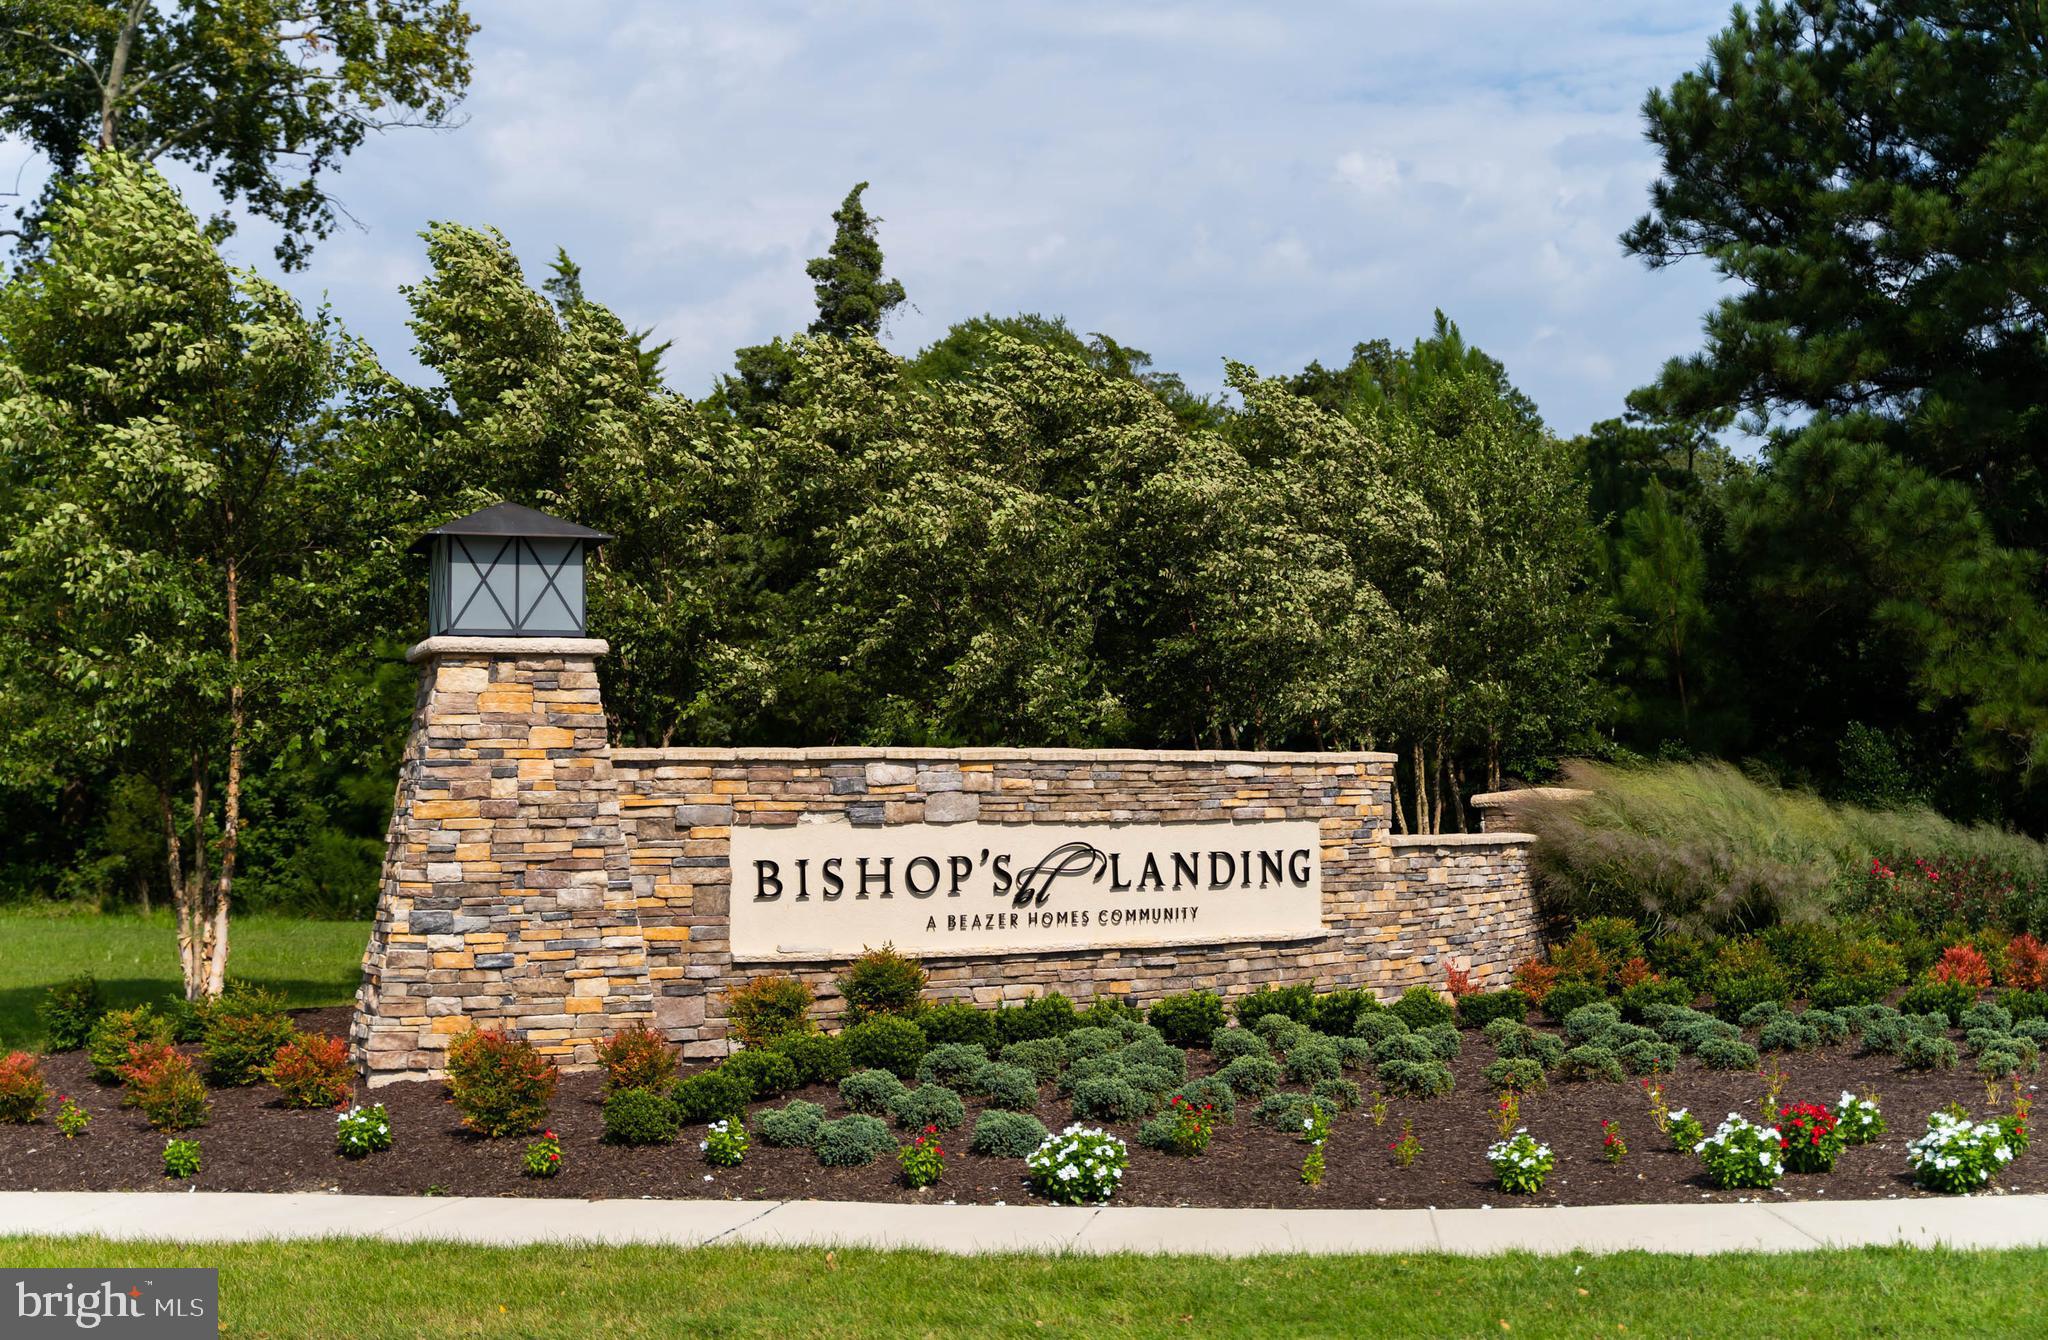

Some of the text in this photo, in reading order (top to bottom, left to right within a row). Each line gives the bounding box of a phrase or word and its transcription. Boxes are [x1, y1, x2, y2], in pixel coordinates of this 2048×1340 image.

[753, 848, 1312, 900] BISHOP'S LANDING
[926, 906, 1199, 931] A BEAZER HOMES COMMUNITY
